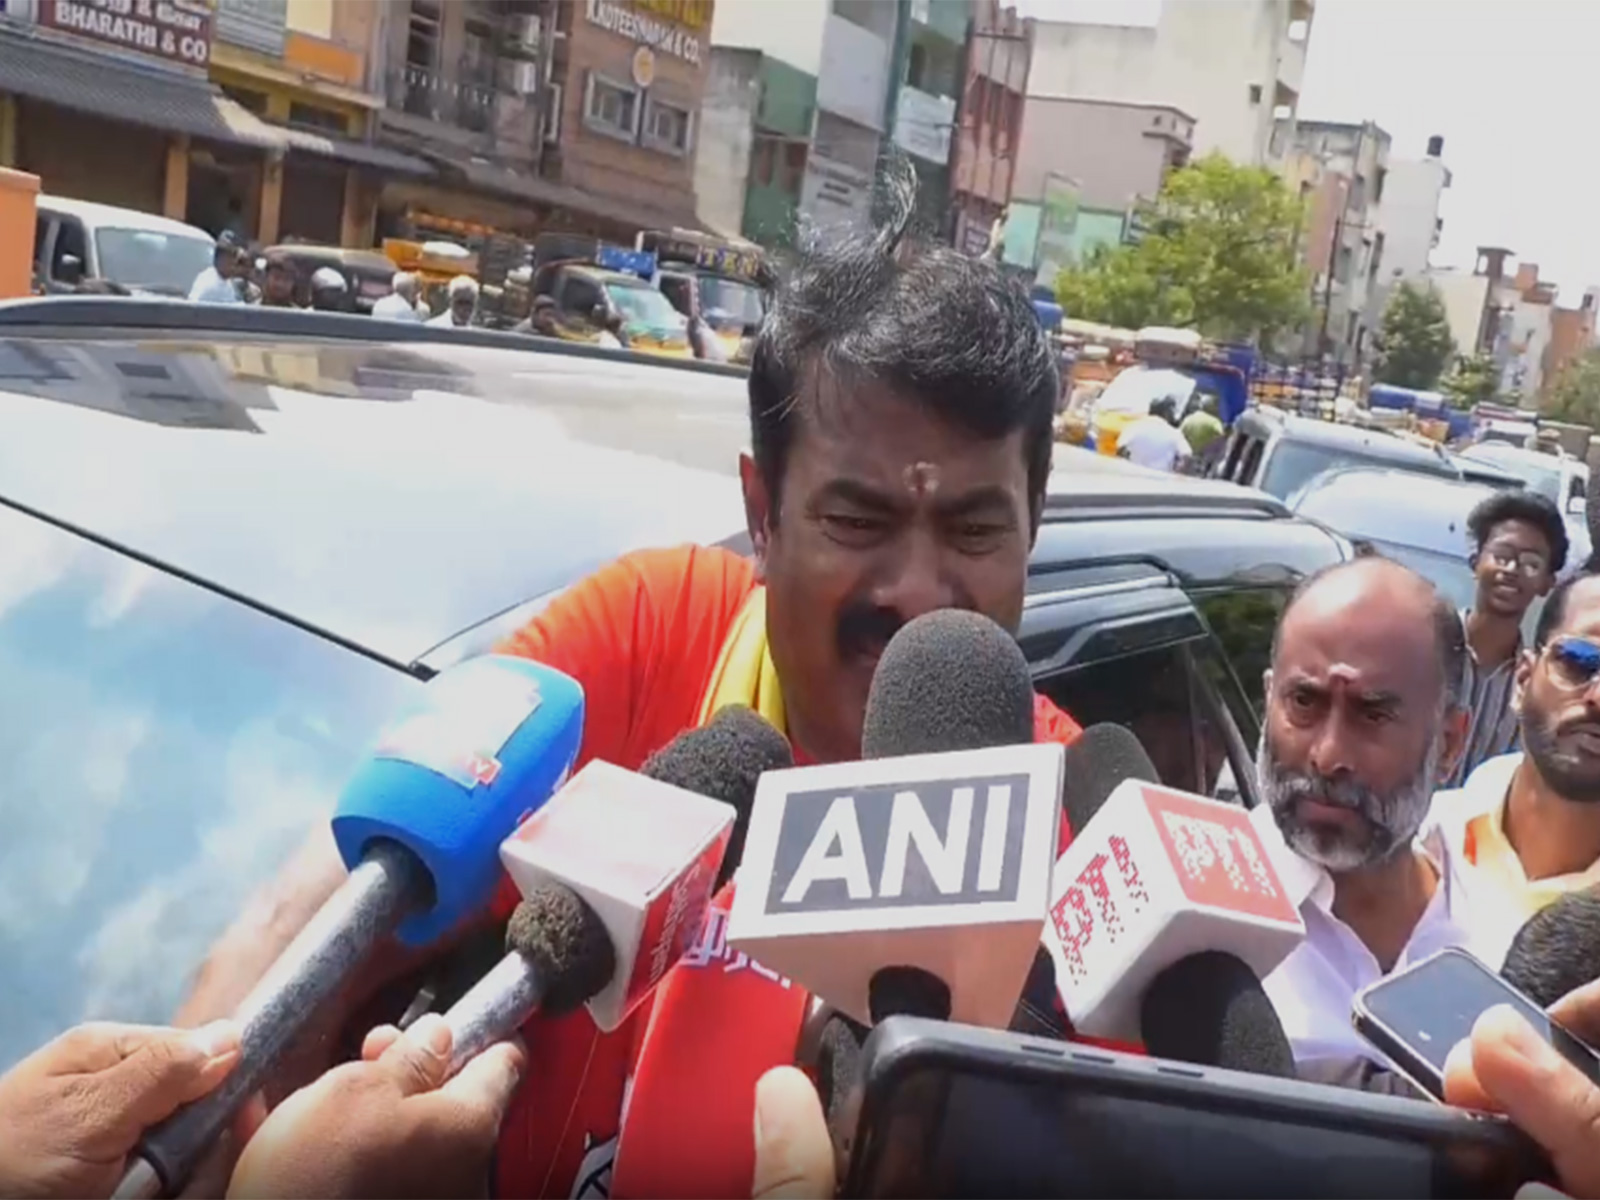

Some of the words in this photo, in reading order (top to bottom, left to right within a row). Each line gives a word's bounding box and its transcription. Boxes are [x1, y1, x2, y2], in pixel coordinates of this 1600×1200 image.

[54, 1, 158, 48] BHARATHI
[160, 30, 177, 55] &
[180, 36, 207, 62] CO
[781, 784, 1012, 903] ANI
[1160, 809, 1278, 897] PTI
[1050, 834, 1149, 985] PTI
